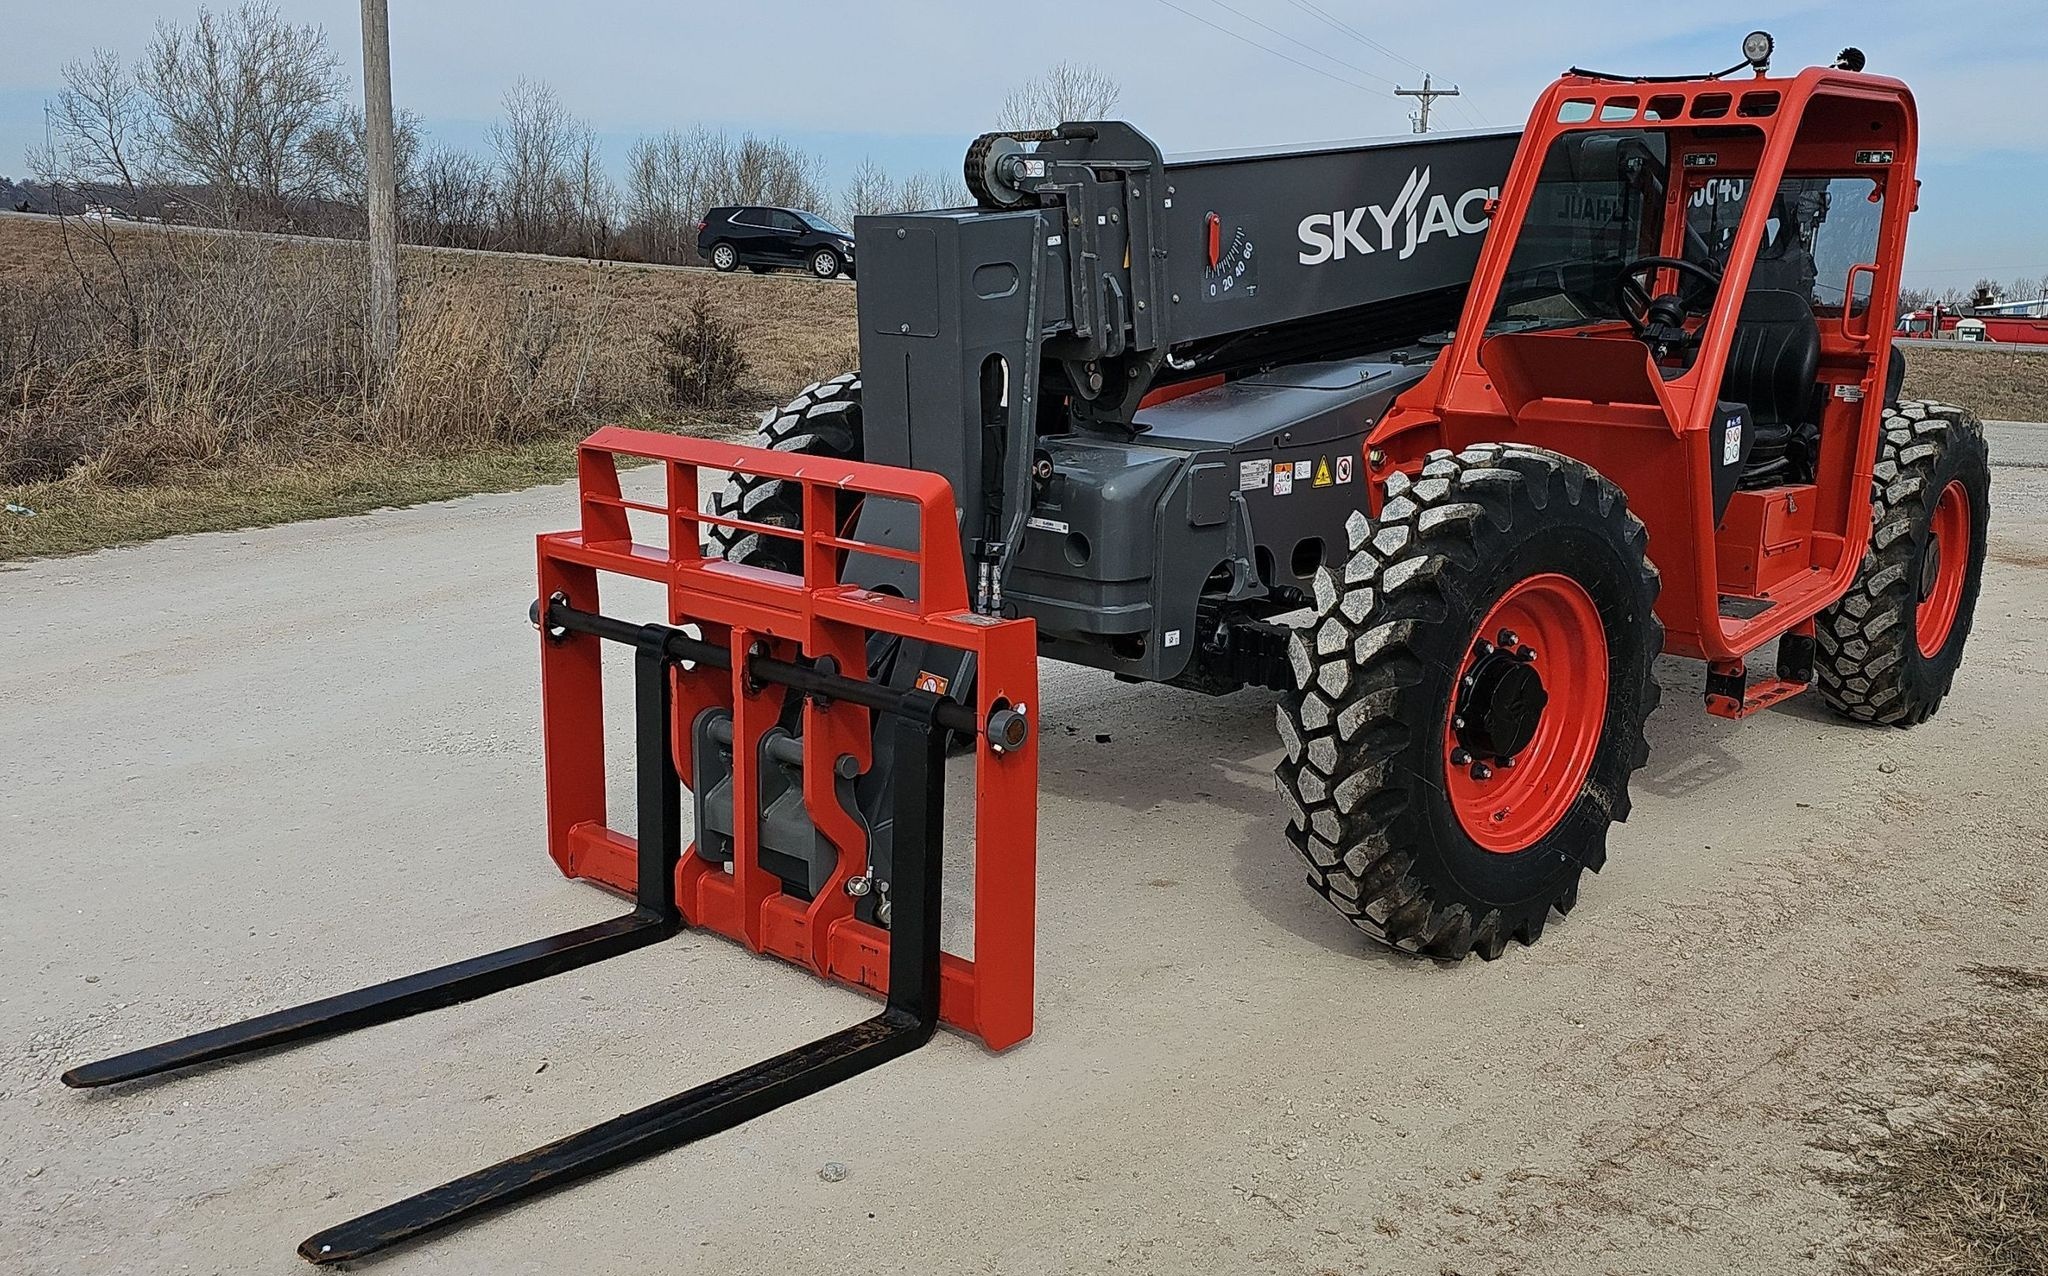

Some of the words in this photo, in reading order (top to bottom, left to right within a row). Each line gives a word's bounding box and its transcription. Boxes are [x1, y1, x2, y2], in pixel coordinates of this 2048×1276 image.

[1297, 165, 1499, 266] SKYJAC
[1243, 241, 1253, 259] 60
[1235, 260, 1245, 278] 40
[1210, 283, 1216, 297] 0
[1222, 275, 1234, 292] 20
